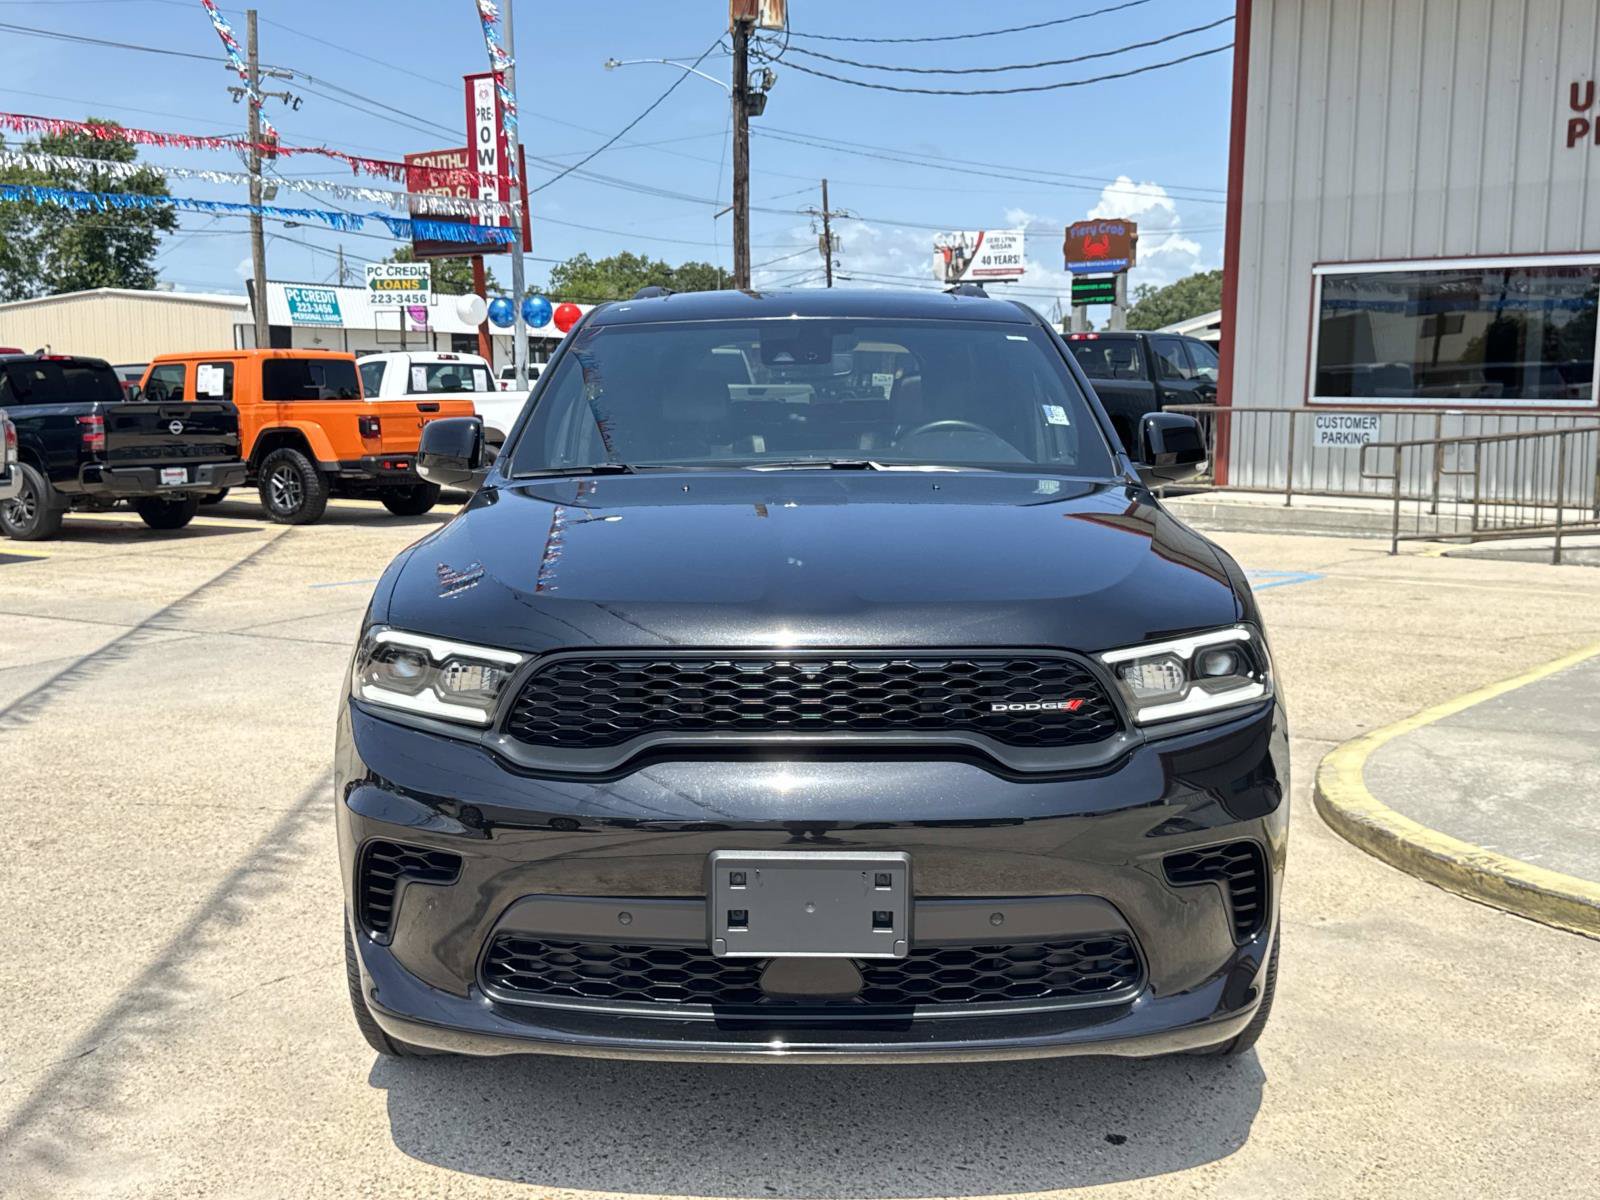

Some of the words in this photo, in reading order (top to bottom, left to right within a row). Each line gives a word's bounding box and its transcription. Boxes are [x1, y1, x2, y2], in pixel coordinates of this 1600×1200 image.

[1566, 117, 1600, 148] P
[981, 255, 991, 265] 40
[994, 254, 1020, 264] YEARS!
[367, 266, 382, 277] PC
[386, 266, 428, 276] CREDIT
[376, 280, 420, 290] LOANS
[286, 288, 301, 302] PC
[301, 290, 336, 304] CREDIT
[370, 294, 427, 304] 223-3456
[1315, 416, 1377, 430] CUSTOMER
[1320, 431, 1370, 445] PARKING
[991, 702, 1069, 712] DODGE
